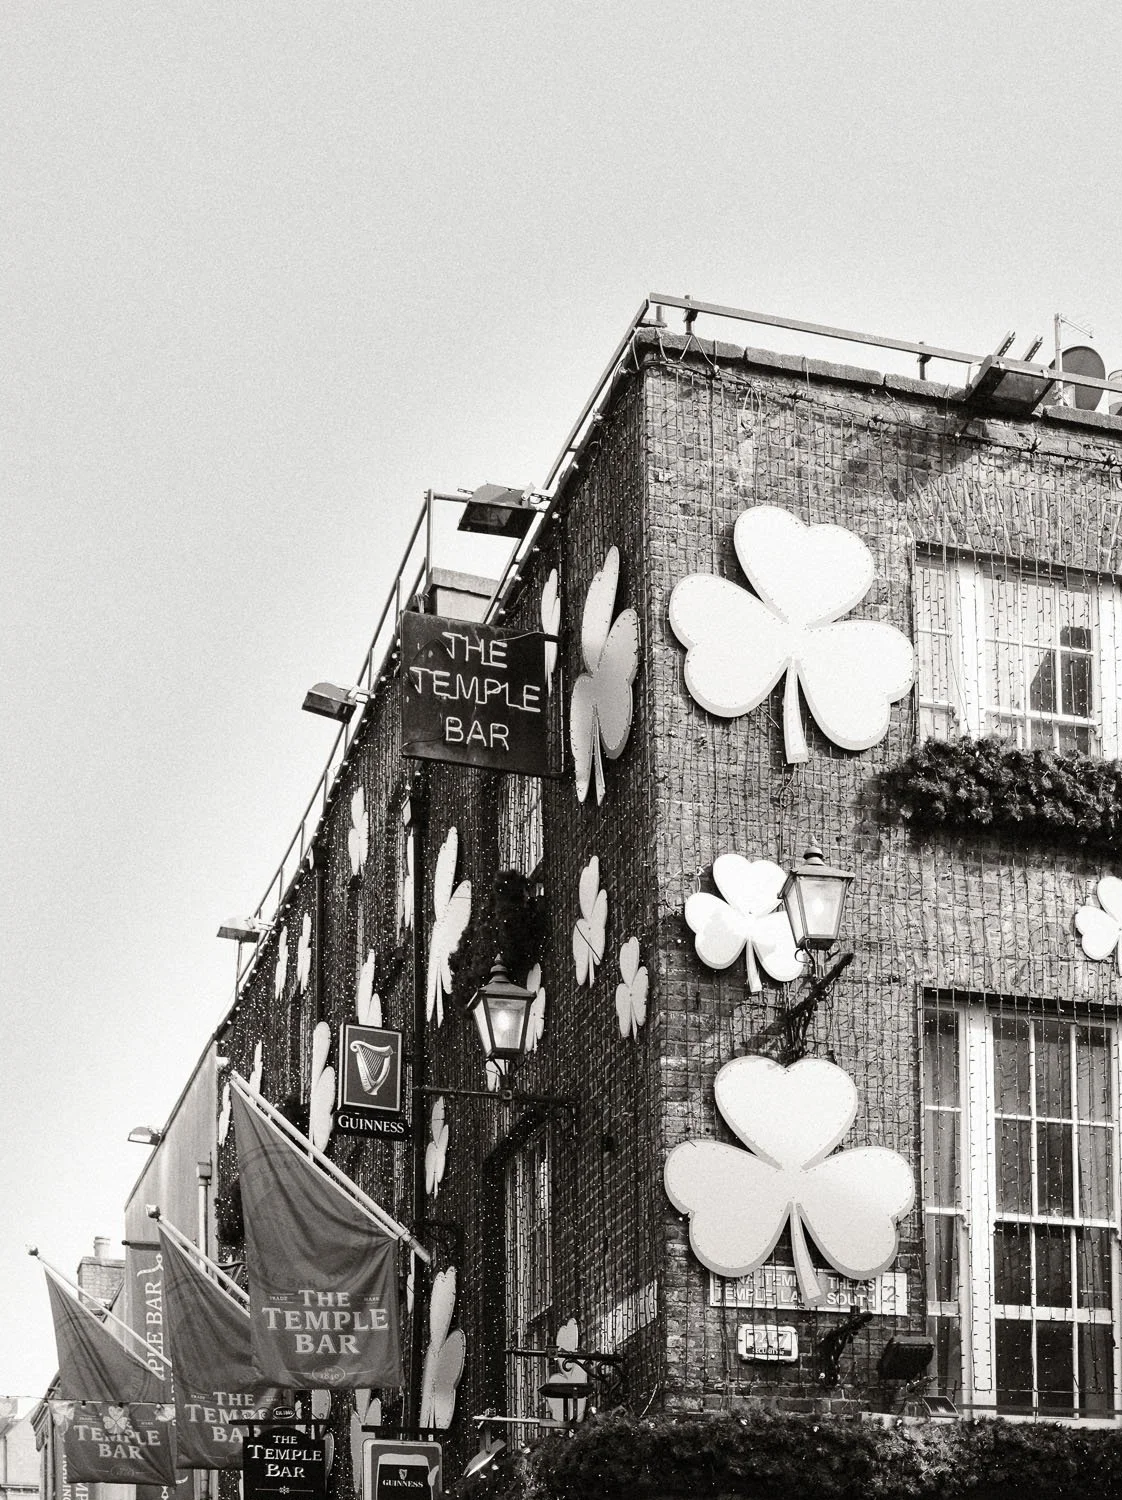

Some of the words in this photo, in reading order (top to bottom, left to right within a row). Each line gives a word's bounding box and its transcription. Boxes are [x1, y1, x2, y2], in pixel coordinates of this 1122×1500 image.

[442, 631, 507, 668] THE
[410, 667, 541, 712] TEMPLE
[446, 716, 509, 750] BAR
[338, 1115, 405, 1134] GUINNESS
[145, 1280, 163, 1325] BAR
[298, 1289, 351, 1307] THE
[715, 1287, 772, 1302] TEMPLE
[827, 1292, 876, 1308] SOUTH
[261, 1307, 388, 1331] TEMPLE
[294, 1333, 361, 1355] BAR
[213, 1391, 255, 1406] THE
[272, 1435, 298, 1444] THE
[98, 1443, 145, 1460] BAR
[247, 1445, 323, 1461] TEMPLE
[265, 1463, 305, 1478] BAR
[382, 1480, 424, 1488] GUINNESS
